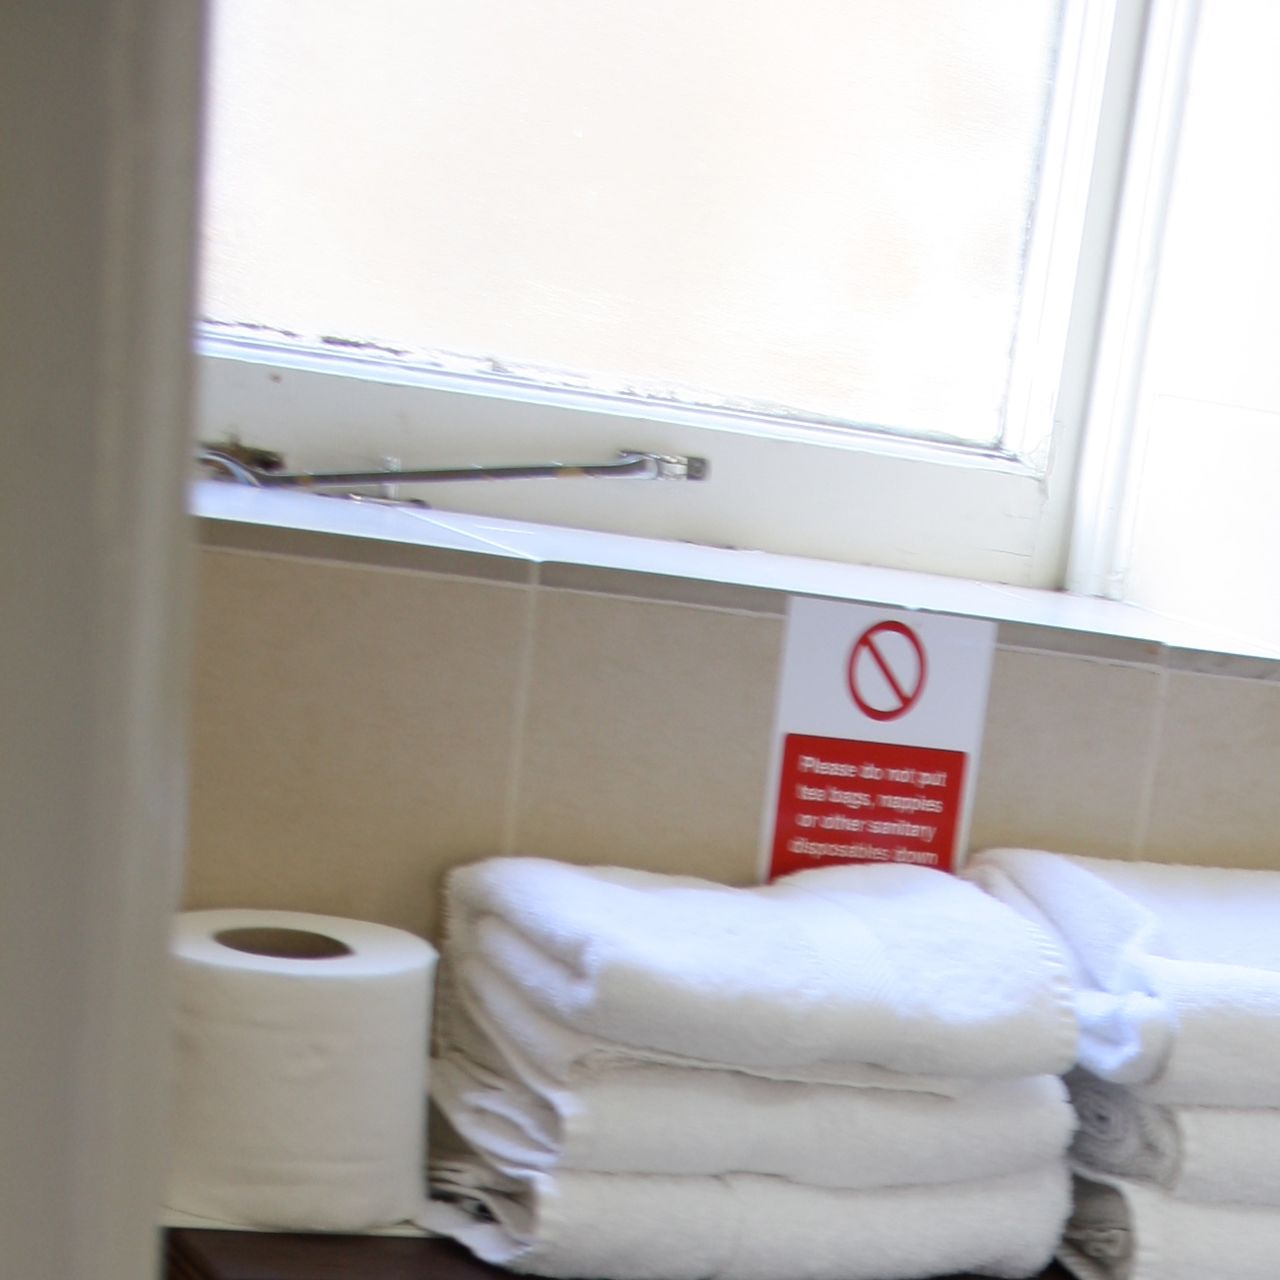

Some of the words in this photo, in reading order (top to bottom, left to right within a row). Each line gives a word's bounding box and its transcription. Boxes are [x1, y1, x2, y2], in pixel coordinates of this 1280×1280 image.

[799, 755, 857, 777] Please
[859, 763, 882, 780] do
[886, 768, 915, 784] not
[915, 771, 947, 788] put
[796, 783, 826, 801] tea
[877, 794, 944, 813] nappies
[795, 813, 818, 828] or
[820, 814, 865, 832] other
[866, 818, 937, 842] sanitary
[787, 836, 890, 860] disposables
[892, 845, 938, 864] down
